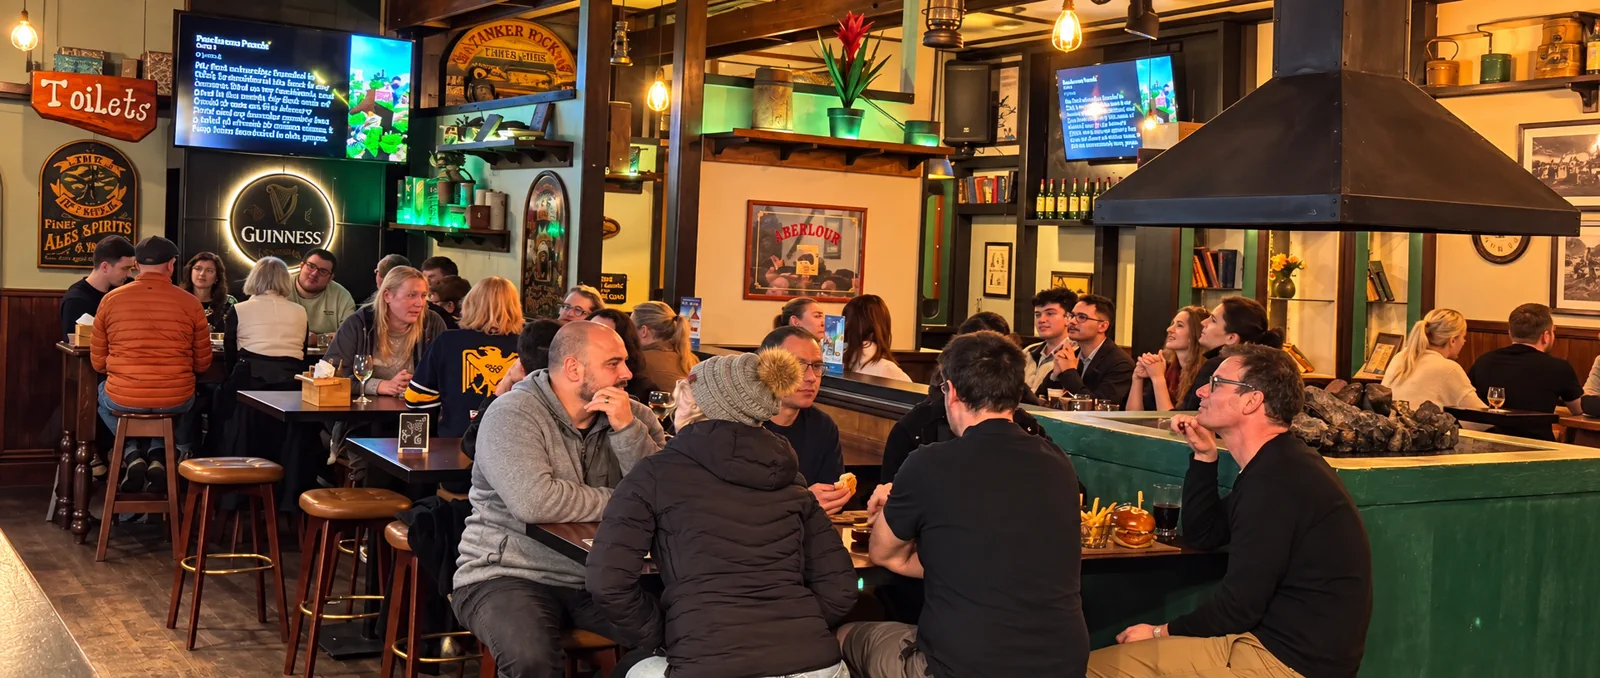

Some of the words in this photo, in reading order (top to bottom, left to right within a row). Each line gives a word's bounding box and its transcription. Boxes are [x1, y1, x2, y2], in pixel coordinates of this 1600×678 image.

[40, 78, 151, 122] Toilets
[240, 225, 322, 245] GUINNESS
[775, 222, 842, 246] ABERLOUR
